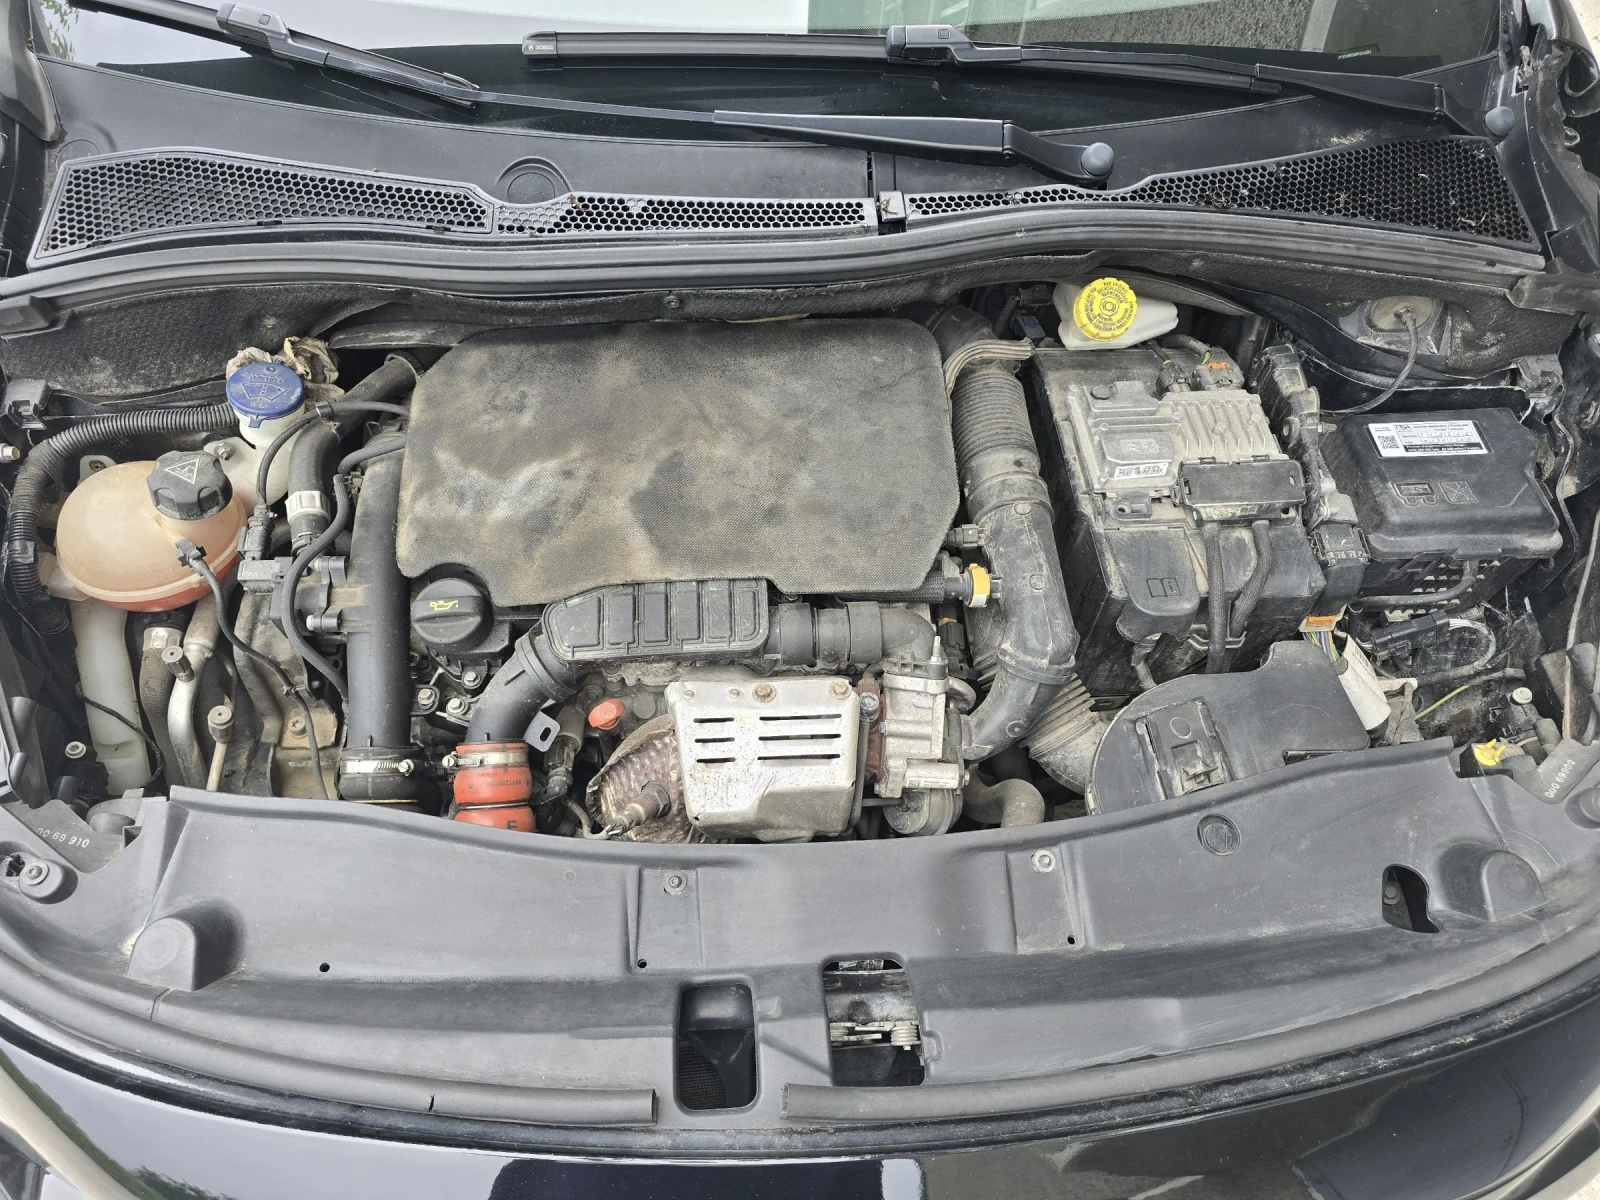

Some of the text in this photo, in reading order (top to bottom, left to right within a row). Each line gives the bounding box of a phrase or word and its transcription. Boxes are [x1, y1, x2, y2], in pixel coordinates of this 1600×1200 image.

[34, 826, 90, 848] 00 69 910
